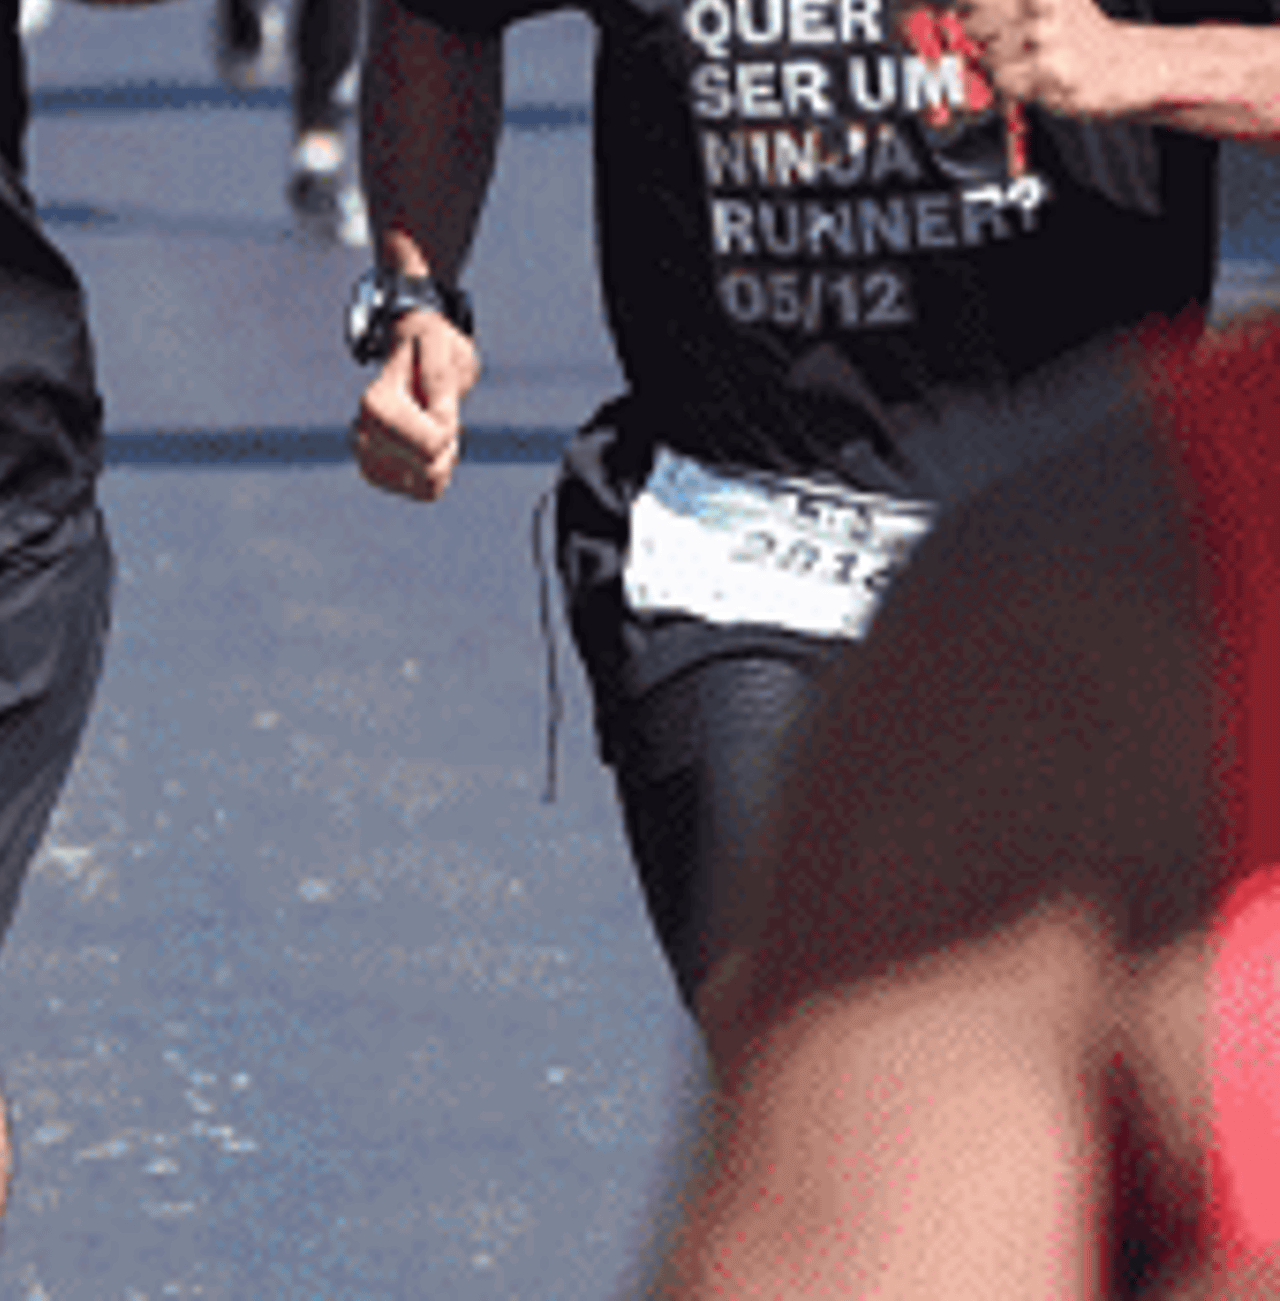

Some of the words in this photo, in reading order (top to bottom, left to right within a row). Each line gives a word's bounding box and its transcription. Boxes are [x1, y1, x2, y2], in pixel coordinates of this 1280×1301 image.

[692, 61, 834, 117] SER
[849, 54, 965, 112] UM
[702, 124, 920, 186] NINJA
[711, 176, 1046, 254] RUNNER?
[720, 272, 912, 331] 05/12
